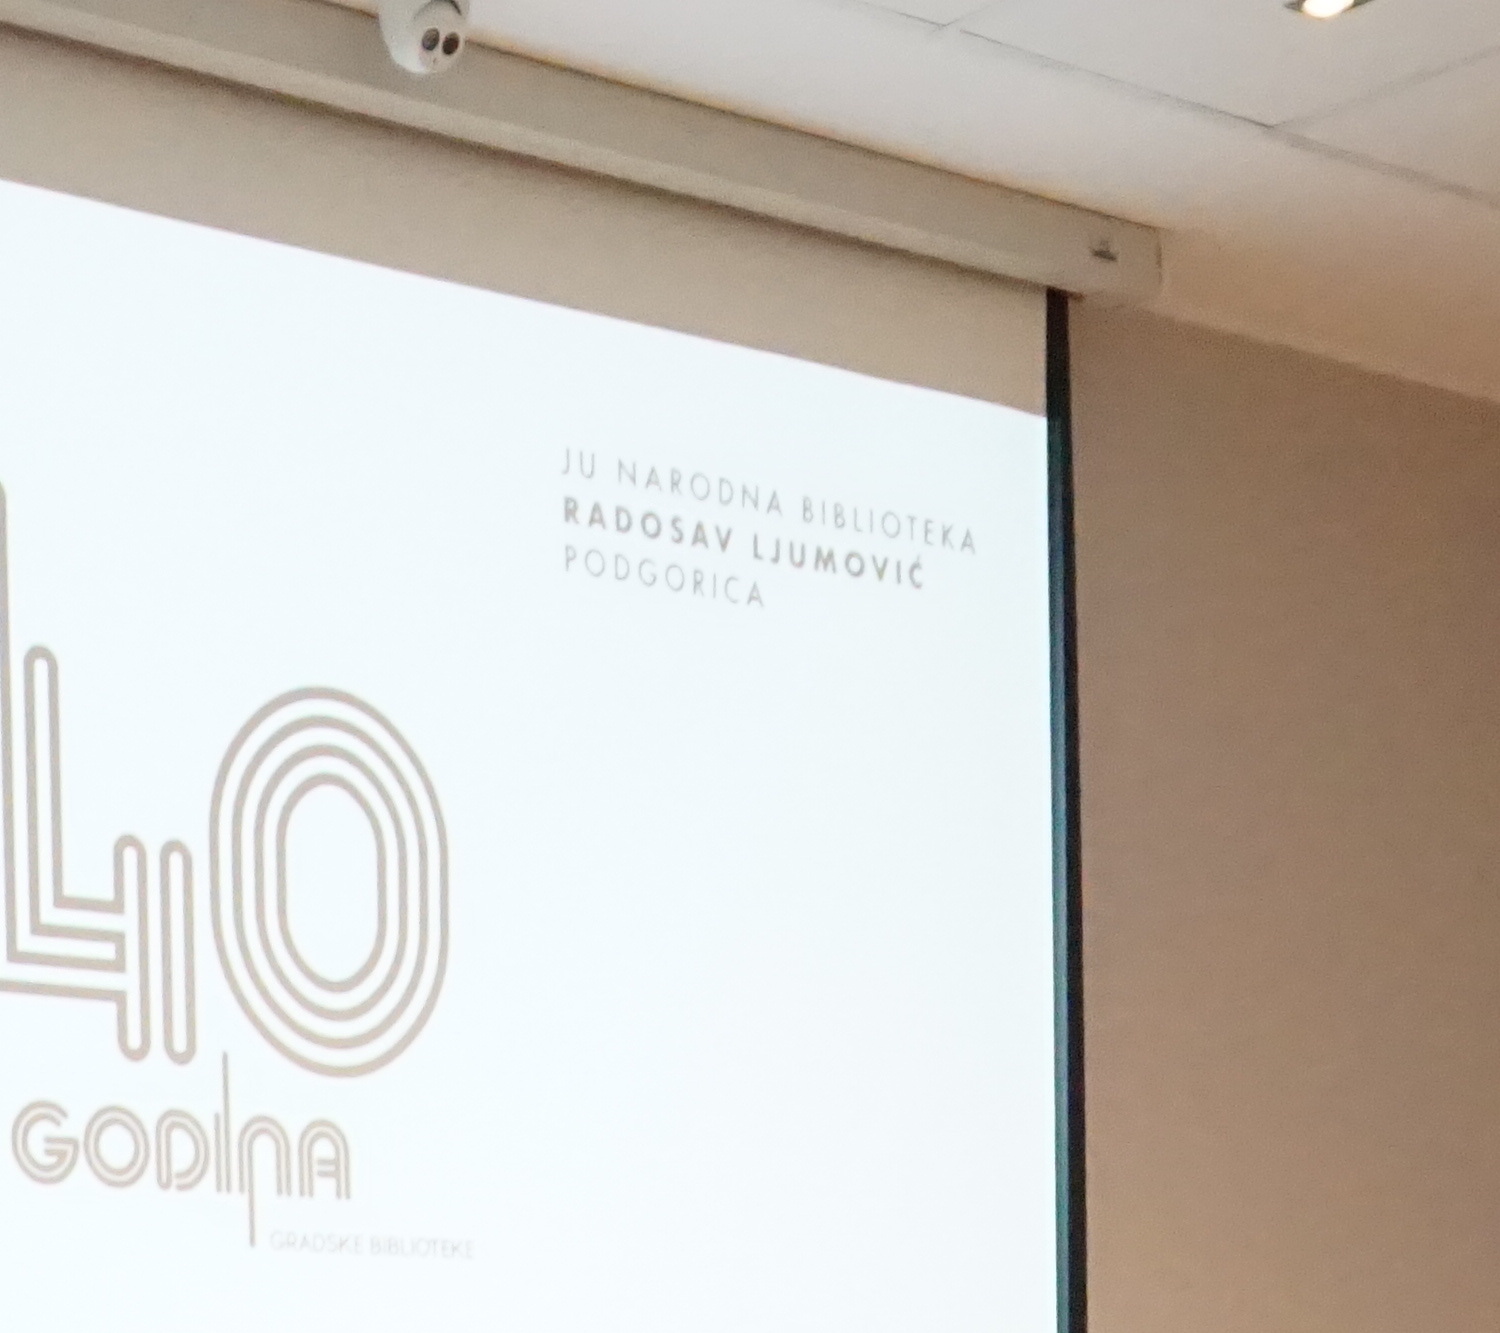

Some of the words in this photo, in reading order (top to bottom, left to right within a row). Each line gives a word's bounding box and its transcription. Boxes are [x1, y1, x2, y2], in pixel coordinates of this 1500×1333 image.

[561, 447, 595, 479] JU
[617, 458, 782, 515] NARODNA
[803, 496, 976, 553] BIBLIOTEKA
[564, 497, 732, 553] RADOSAV
[754, 532, 923, 589] LJUMOVIĆ
[565, 545, 763, 607] PODGORICA
[270, 1231, 363, 1255] GRADSKE
[370, 1235, 474, 1259] BIBLIOTEKE
